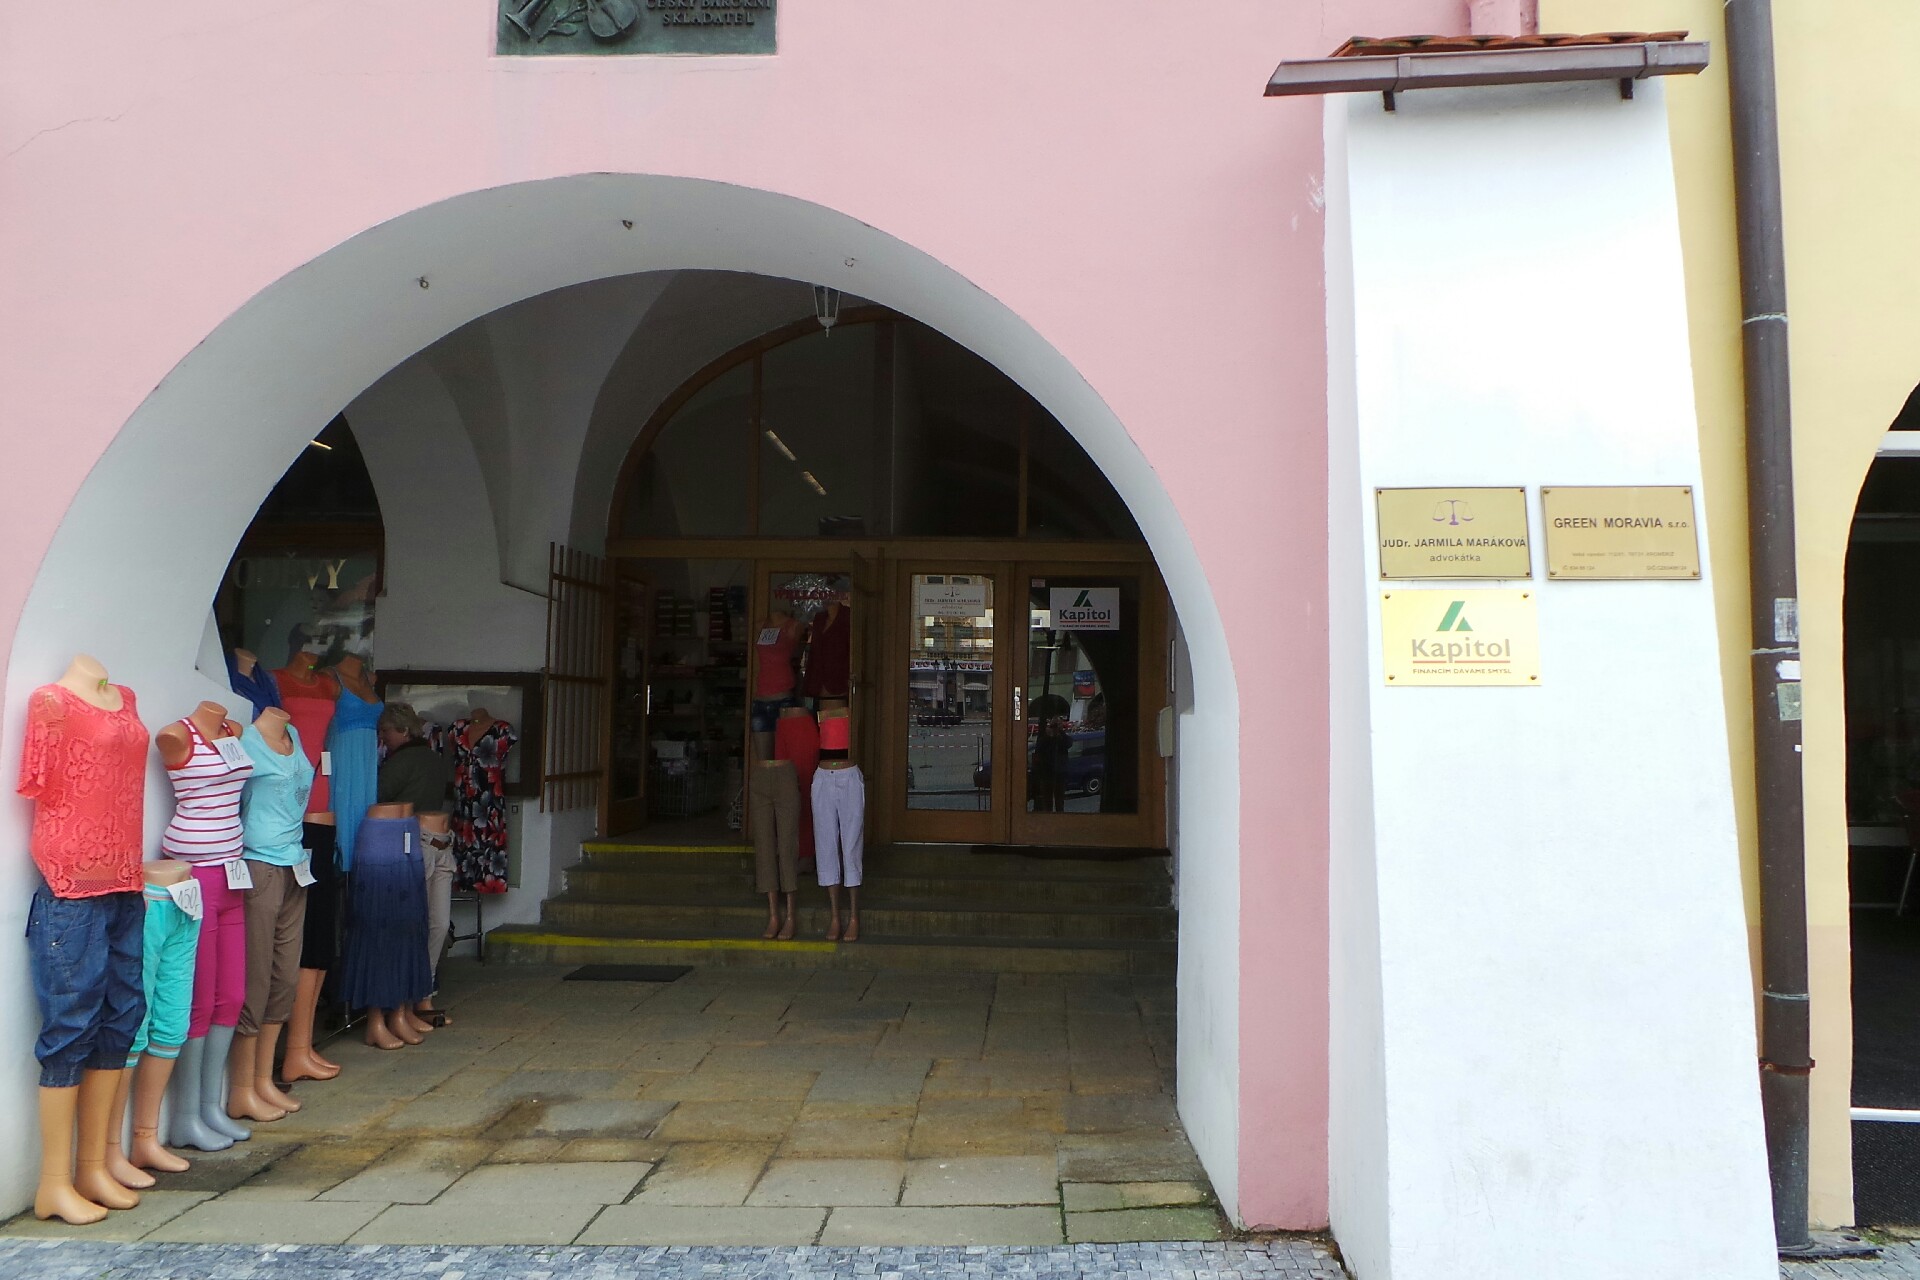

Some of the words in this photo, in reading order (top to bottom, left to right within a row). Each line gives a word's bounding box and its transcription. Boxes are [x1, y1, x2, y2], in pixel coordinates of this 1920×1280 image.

[663, 12, 755, 25] SKLADATEL
[1554, 517, 1597, 528] GREEN
[1604, 517, 1663, 528] MORAVIA
[1668, 520, 1690, 528] s.r.o.
[1382, 538, 1411, 548] JUDr.
[1414, 538, 1463, 547] JARMILA
[1466, 536, 1526, 547] MARÁKOVÁ
[1430, 553, 1481, 562] advokátka
[1059, 608, 1111, 622] Kapitol
[1411, 637, 1511, 663] Kapitol
